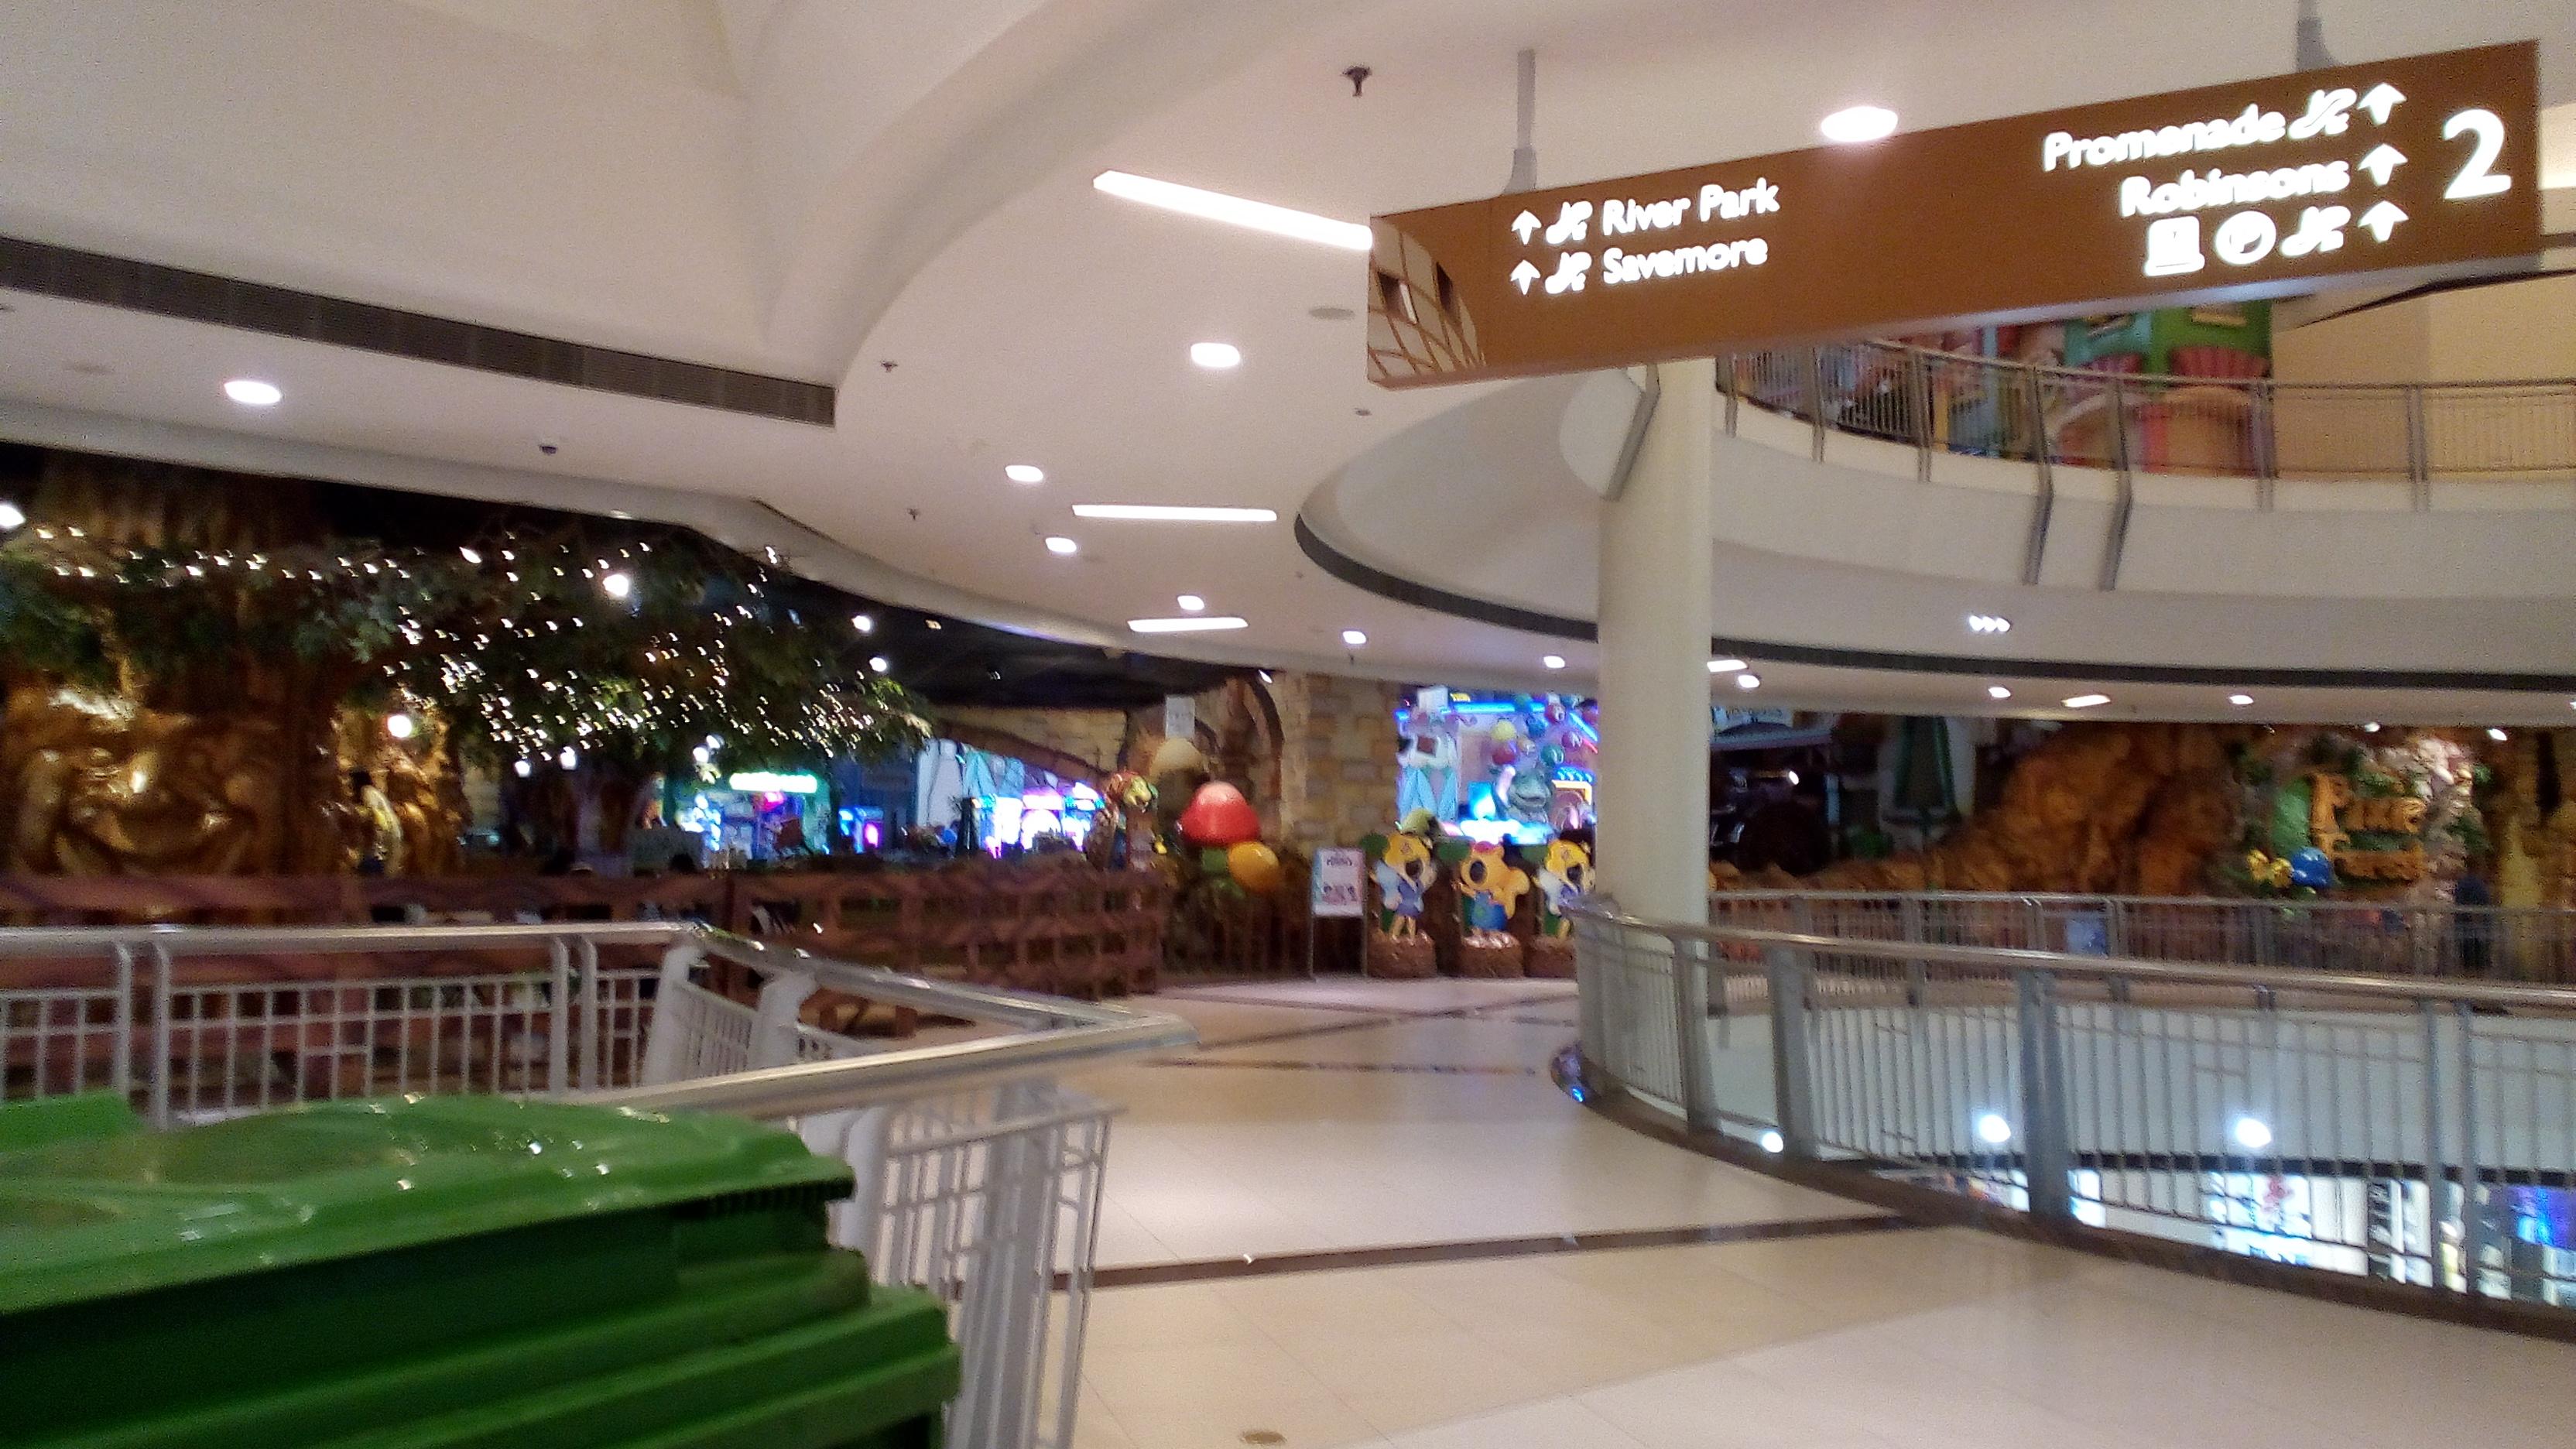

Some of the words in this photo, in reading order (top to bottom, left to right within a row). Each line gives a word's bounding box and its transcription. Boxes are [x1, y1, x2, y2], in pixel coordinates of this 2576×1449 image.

[2043, 103, 2287, 173] Promenade
[2443, 108, 2513, 200] 2
[1602, 197, 1691, 236] River
[1699, 176, 1780, 222] Park
[2119, 159, 2351, 218] Robinsons
[1602, 237, 1769, 284] Savemore
